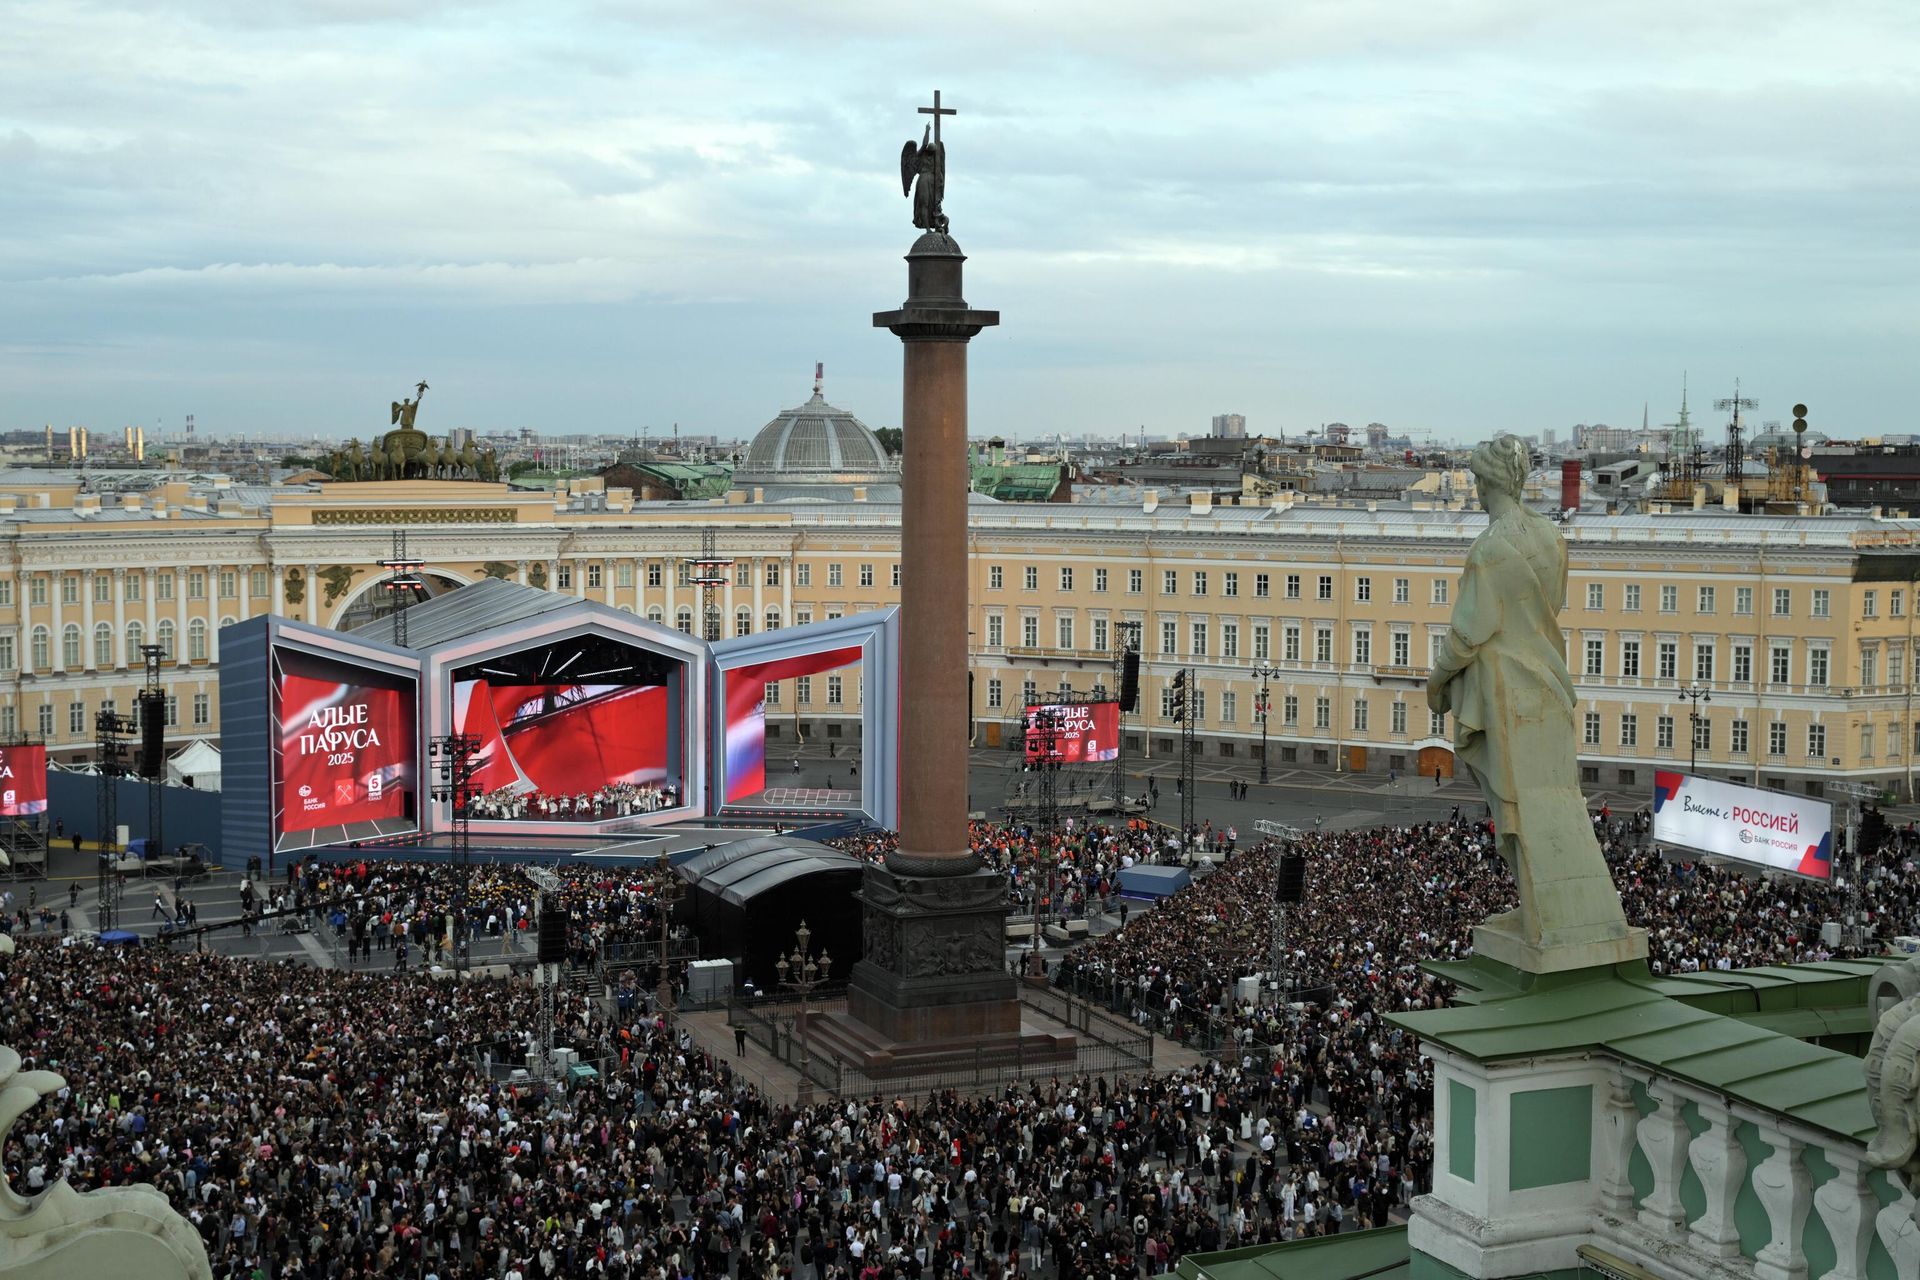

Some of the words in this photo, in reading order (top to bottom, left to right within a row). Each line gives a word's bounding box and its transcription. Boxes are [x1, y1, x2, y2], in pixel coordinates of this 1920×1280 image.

[308, 704, 368, 728] АЛЫЕ
[300, 726, 381, 755] ПАРУСА
[327, 752, 354, 766] 2025
[371, 778, 379, 789] 5
[303, 797, 318, 805] БАНК
[303, 803, 326, 811] РОССИЯ
[1684, 795, 1720, 817] Вместе
[1723, 811, 1729, 820] с
[1733, 806, 1798, 835] РОССИЕЙ
[1754, 835, 1770, 845] БАНК
[1771, 839, 1798, 851] РОССИЯ
